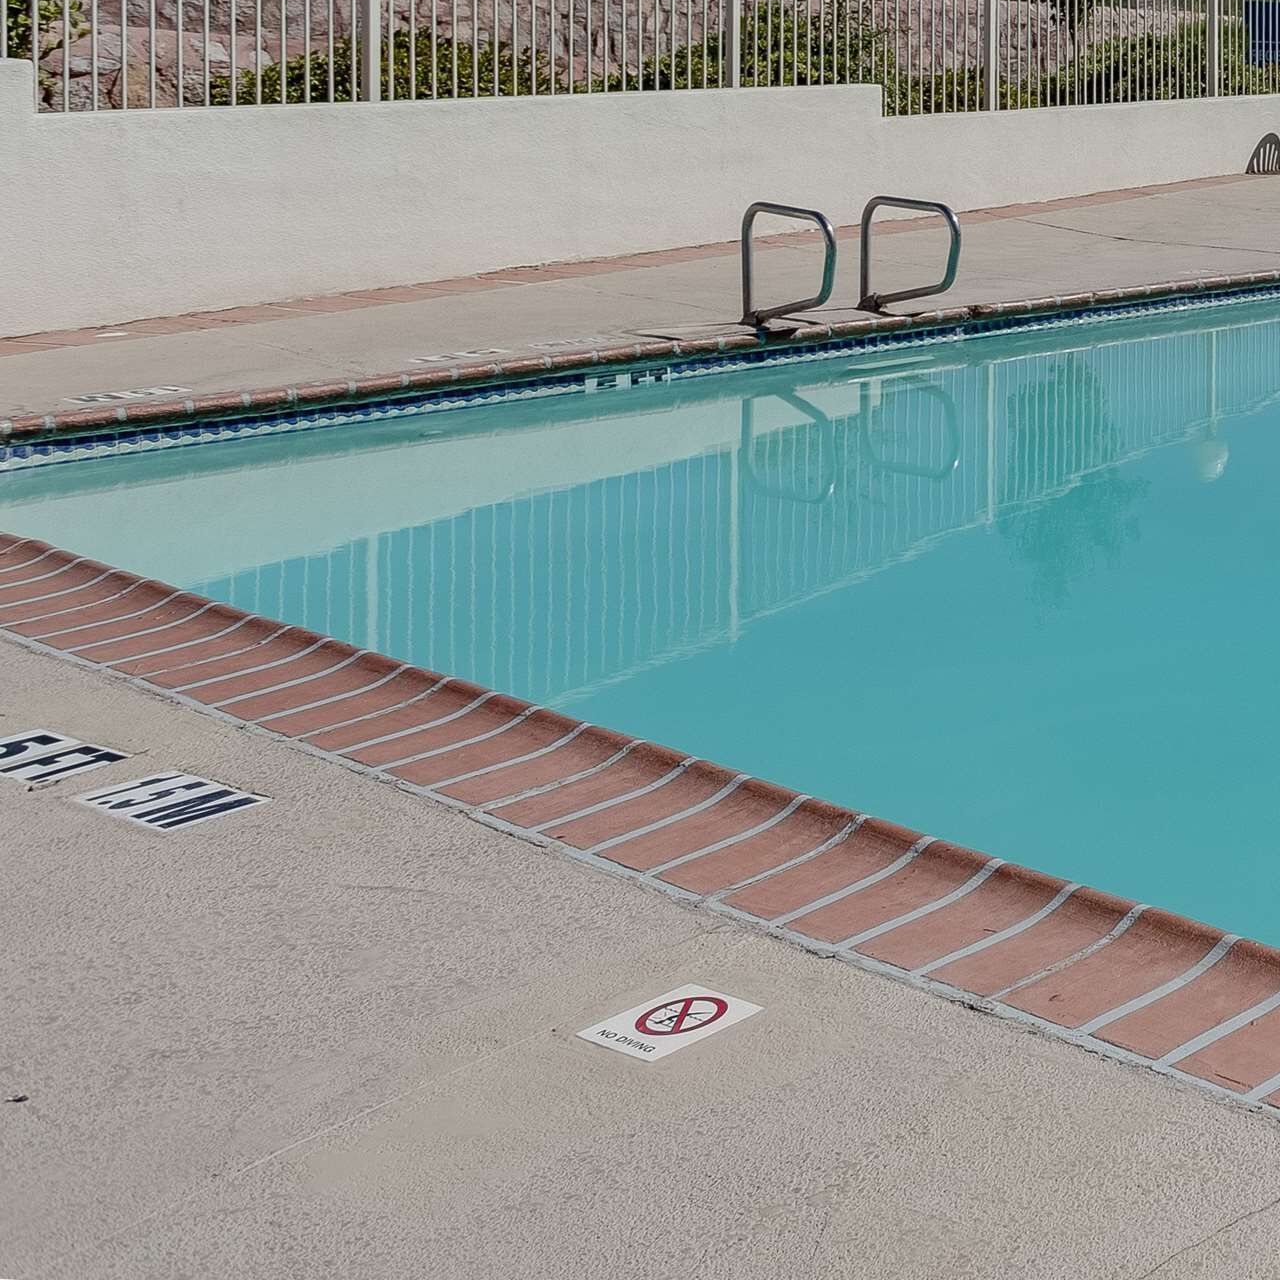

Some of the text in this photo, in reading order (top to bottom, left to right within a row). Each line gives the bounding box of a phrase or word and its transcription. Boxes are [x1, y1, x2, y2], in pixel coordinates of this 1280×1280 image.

[85, 774, 261, 829] 1.5M
[596, 1029, 656, 1053] NO DIVING
